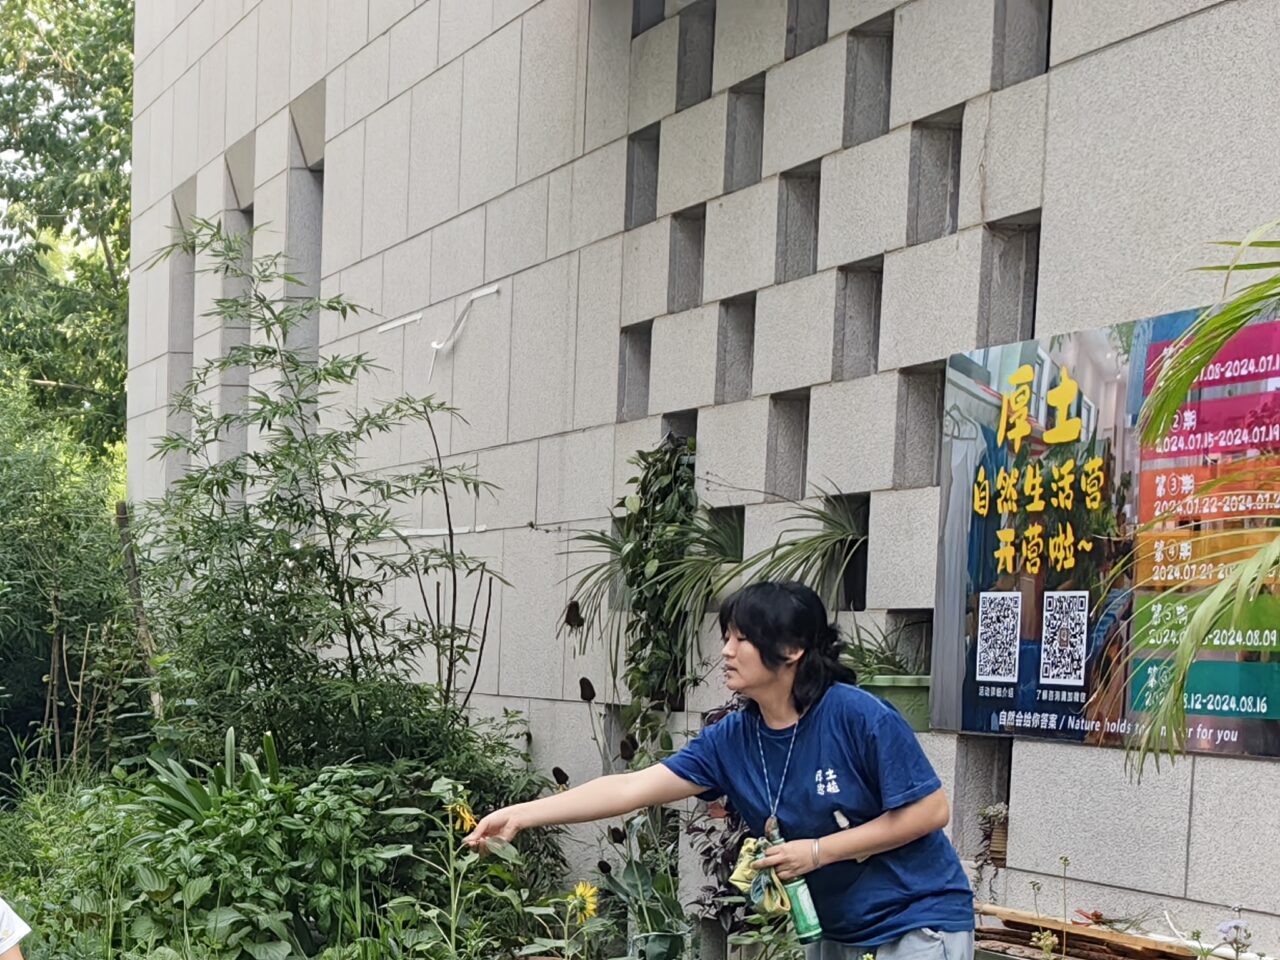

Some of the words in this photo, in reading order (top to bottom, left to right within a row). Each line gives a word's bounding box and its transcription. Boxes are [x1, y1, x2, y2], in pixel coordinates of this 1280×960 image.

[997, 364, 1082, 453] 厚土
[973, 456, 1105, 517] 自然生活营
[999, 710, 1058, 730] 自然会给你答案
[1067, 715, 1101, 731] Nature
[1105, 717, 1132, 734] holds
[1197, 723, 1214, 740] for
[1216, 728, 1238, 744] you
